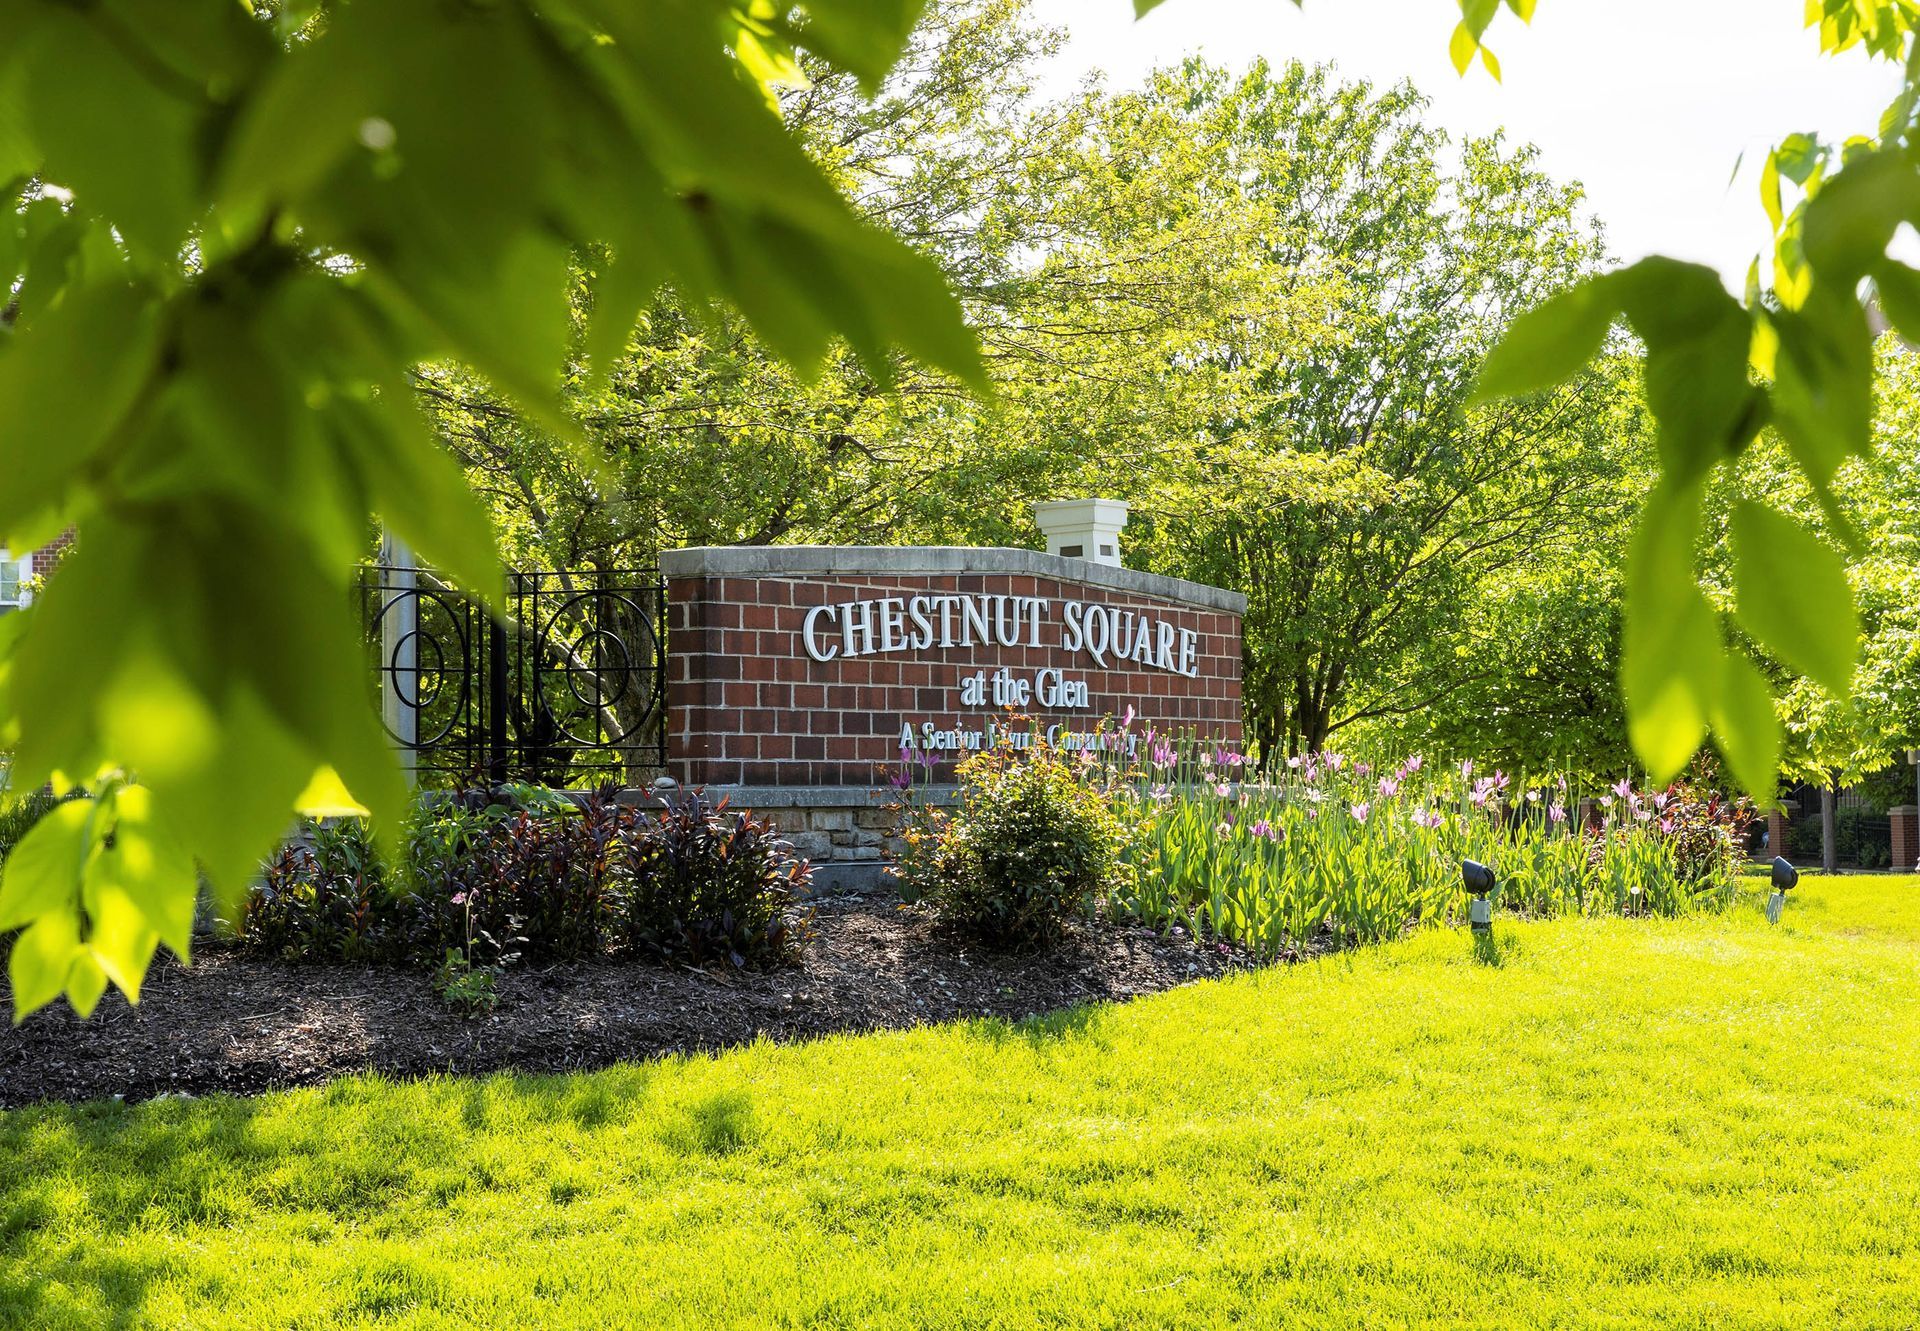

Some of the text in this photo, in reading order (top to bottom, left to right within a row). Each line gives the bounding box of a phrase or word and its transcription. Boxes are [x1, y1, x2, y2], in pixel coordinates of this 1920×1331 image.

[802, 595, 1198, 678] CHESTNUT SQUARE
[960, 667, 1090, 708] at the Glen
[899, 721, 917, 749] A
[922, 721, 983, 750] Senior
